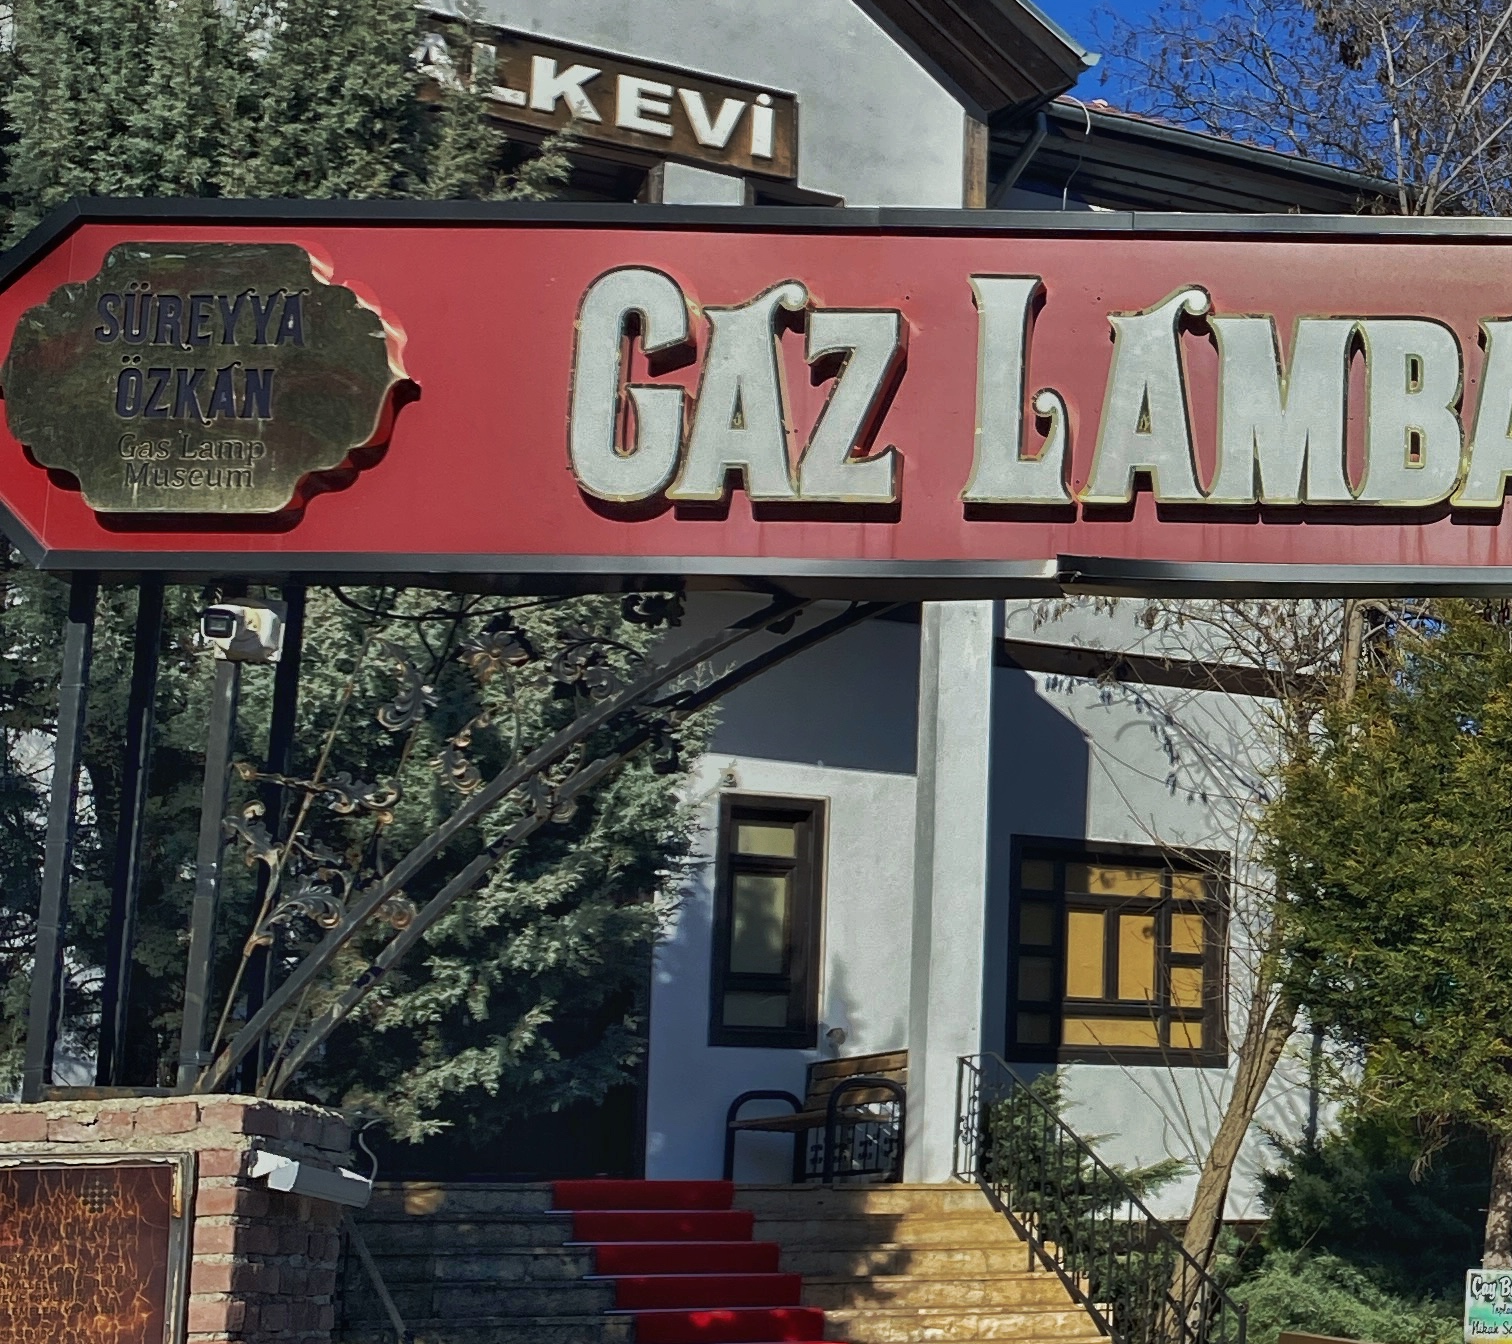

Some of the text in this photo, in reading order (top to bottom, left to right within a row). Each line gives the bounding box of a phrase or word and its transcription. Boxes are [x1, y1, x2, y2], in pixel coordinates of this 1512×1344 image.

[95, 281, 312, 352] SÜREYYA
[115, 355, 275, 426] ÖZKAN
[569, 265, 903, 503] GAZ
[118, 432, 265, 465] Gas Lamp
[126, 462, 254, 489] Museum
[1471, 1275, 1497, 1301] Çay
